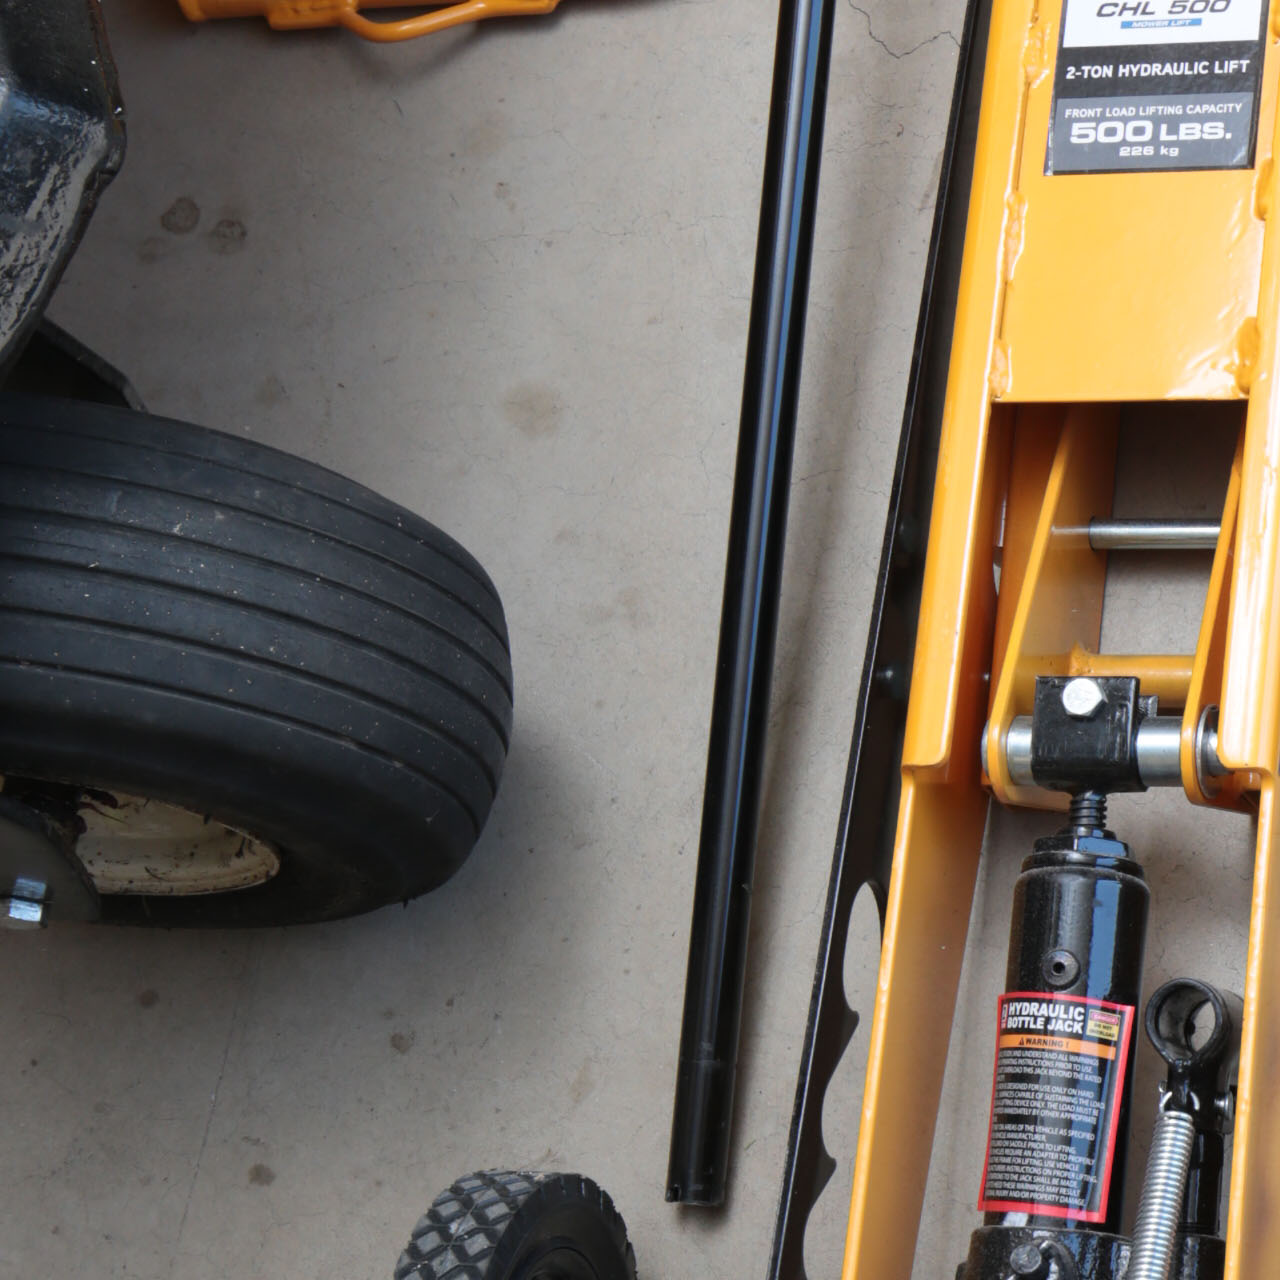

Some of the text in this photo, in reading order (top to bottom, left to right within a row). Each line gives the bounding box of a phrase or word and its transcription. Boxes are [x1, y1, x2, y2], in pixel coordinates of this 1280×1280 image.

[1096, 2, 1155, 17] CHL
[1131, 18, 1192, 28] MOWER LIFT
[1066, 60, 1250, 79] 2-TON HYDRAULIC LIFT
[1064, 103, 1242, 118] FRONT LOAD LIFTING CAPACITY
[1070, 120, 1232, 144] 500 LBS.
[1119, 146, 1179, 157] 226 kg
[1009, 1002, 1084, 1020] HYDRAULIC
[1008, 1017, 1083, 1034] BOTTLE JACK
[1026, 1038, 1064, 1048] WARNING
[1022, 1050, 1057, 1060] UNDERSTAND
[1070, 1055, 1099, 1065] WARNINGS
[1055, 1061, 1072, 1069] PRIOR
[1049, 1069, 1072, 1078] BEYOND
[1085, 1074, 1102, 1083] RATED
[1051, 1086, 1067, 1094] ONLY
[1078, 1089, 1094, 1098] HARD
[1040, 1110, 1059, 1118] OTHER
[1059, 1103, 1075, 1111] LOAD
[1076, 1105, 1091, 1114] MUST
[1036, 1126, 1058, 1135] VEHICLE
[1059, 1128, 1067, 1136] AS
[1068, 1129, 1095, 1140] SPECIFIED
[1032, 1151, 1058, 1160] ADAPTER
[1056, 1161, 1079, 1171] VEHICLE
[1043, 1167, 1074, 1178] ON PROPER
[1020, 1174, 1033, 1182] JACK
[1034, 1176, 1051, 1184] SHALL
[1017, 1182, 1044, 1191] WARNINGS
[1060, 1186, 1079, 1196] RESULT
[1030, 1192, 1060, 1201] PROPERTY
